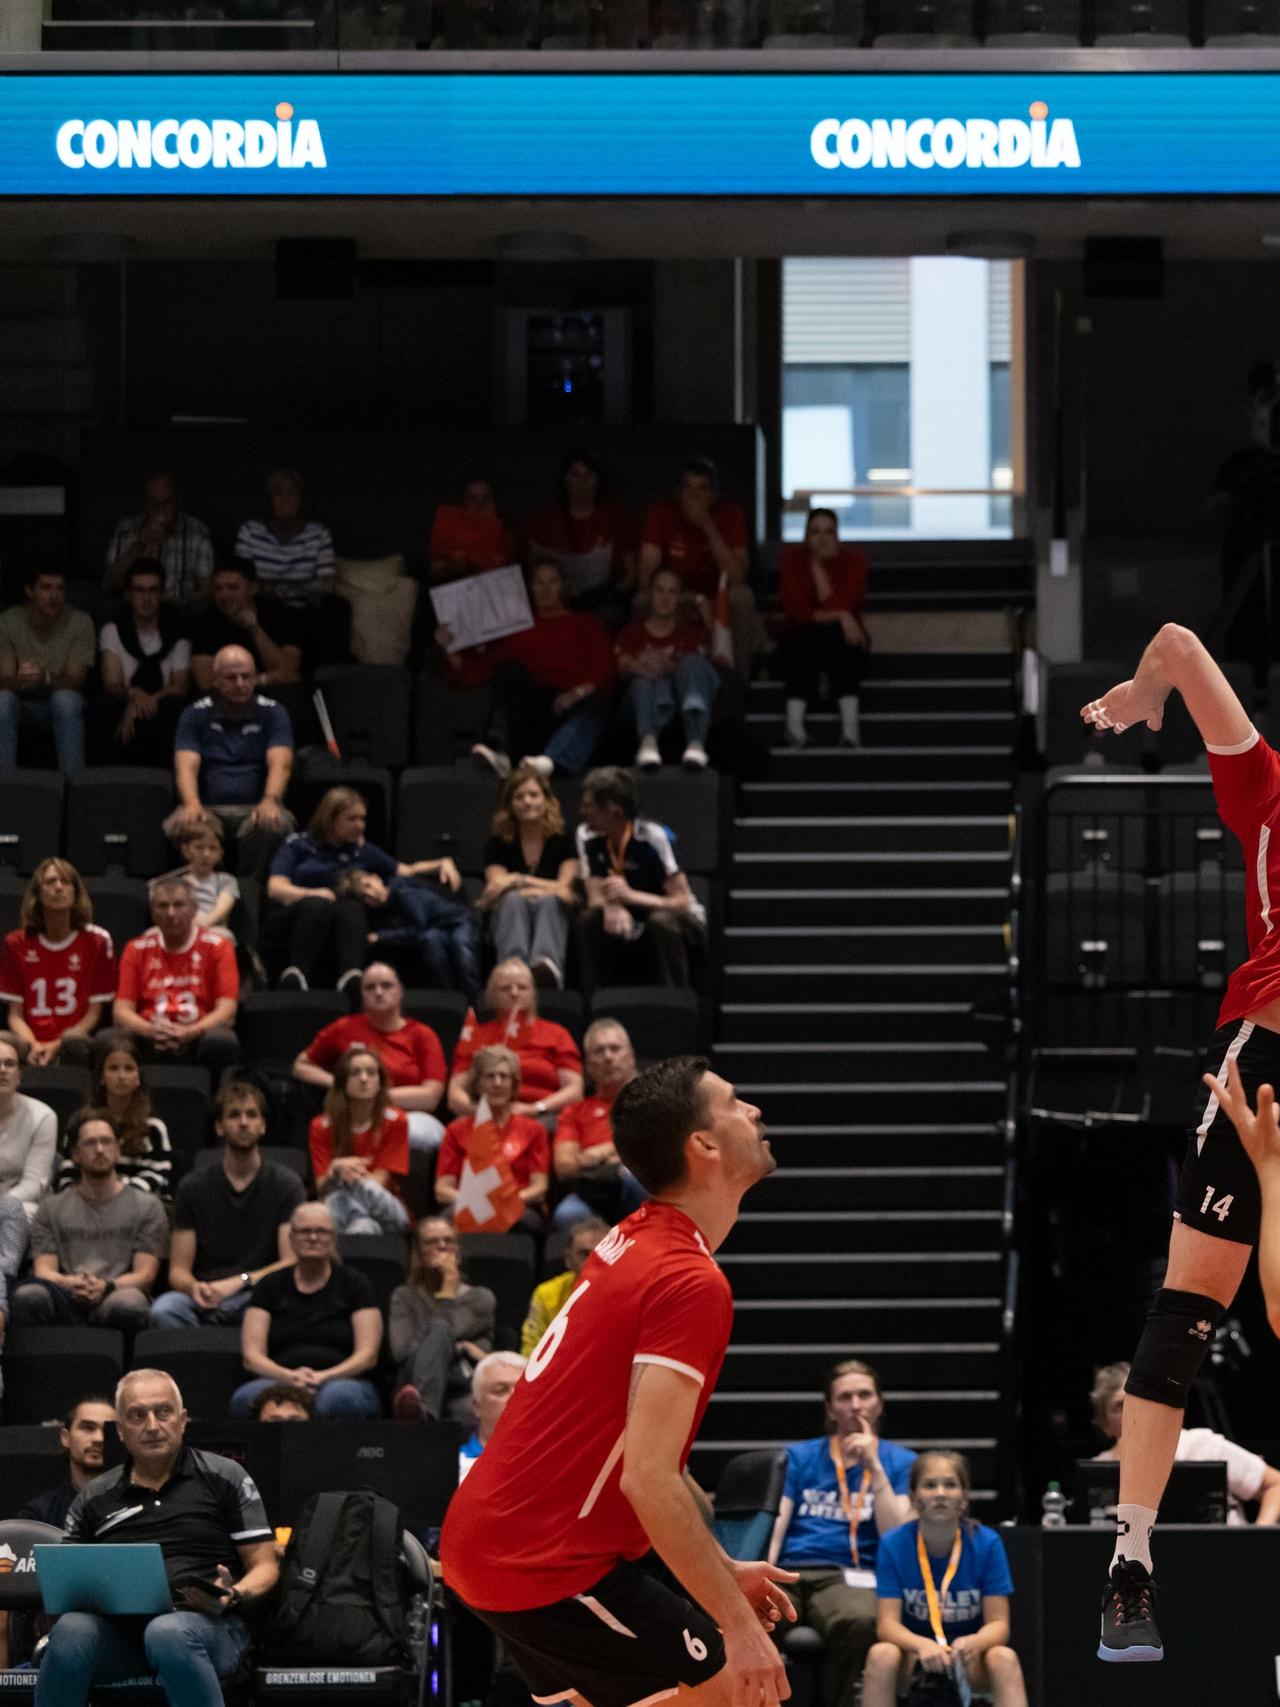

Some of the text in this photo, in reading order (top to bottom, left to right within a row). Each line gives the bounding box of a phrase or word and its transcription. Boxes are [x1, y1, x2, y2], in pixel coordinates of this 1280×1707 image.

[56, 101, 328, 169] CONCORDIA
[810, 100, 1082, 169] CONCORDIA
[29, 976, 79, 1017] 13
[1199, 1184, 1235, 1222] 14
[524, 1279, 592, 1383] 6
[902, 1588, 981, 1608] VOLEY
[682, 1627, 708, 1662] 6
